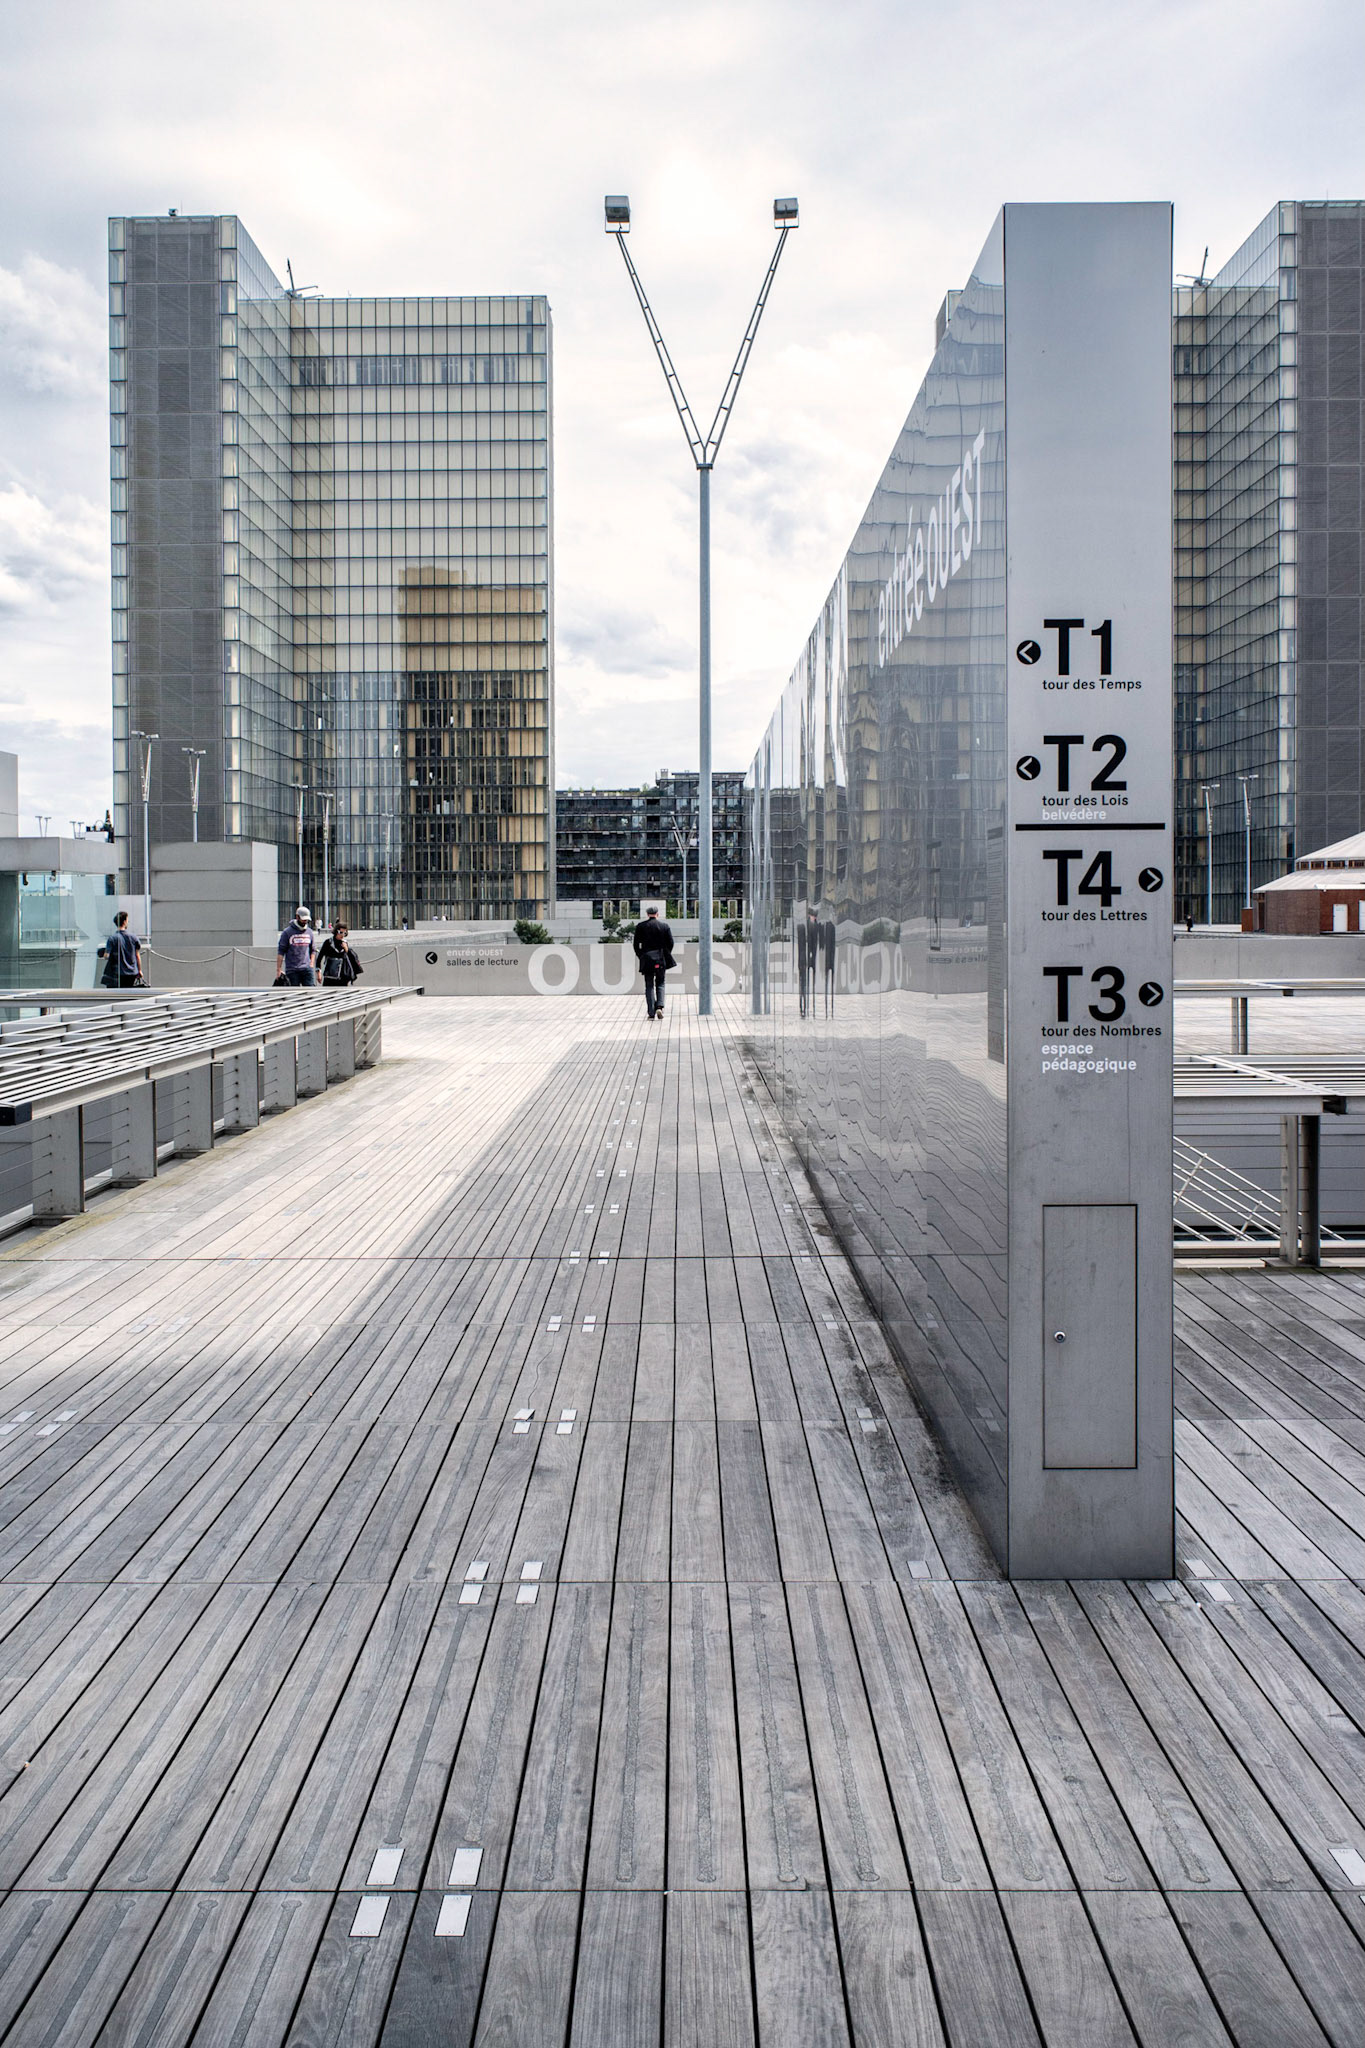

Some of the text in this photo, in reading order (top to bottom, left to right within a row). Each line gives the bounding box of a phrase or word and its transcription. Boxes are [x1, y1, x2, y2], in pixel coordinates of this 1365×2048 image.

[878, 427, 985, 669] entrée OUEST
[1043, 618, 1112, 676] T1
[1042, 679, 1142, 692] tour des Temps
[1043, 734, 1127, 792] T2
[1042, 795, 1129, 806] tour des Lois
[1042, 808, 1107, 820] belvédère
[1042, 850, 1122, 907] T4
[1041, 910, 1148, 921] tour des Lettres
[446, 948, 504, 957] entrée OUEST
[446, 958, 519, 967] salles de lecture
[1042, 966, 1126, 1023] T3
[1041, 1025, 1163, 1037] tour des Nombres
[1041, 1043, 1094, 1058] espace
[1042, 1058, 1137, 1074] pédagogique
